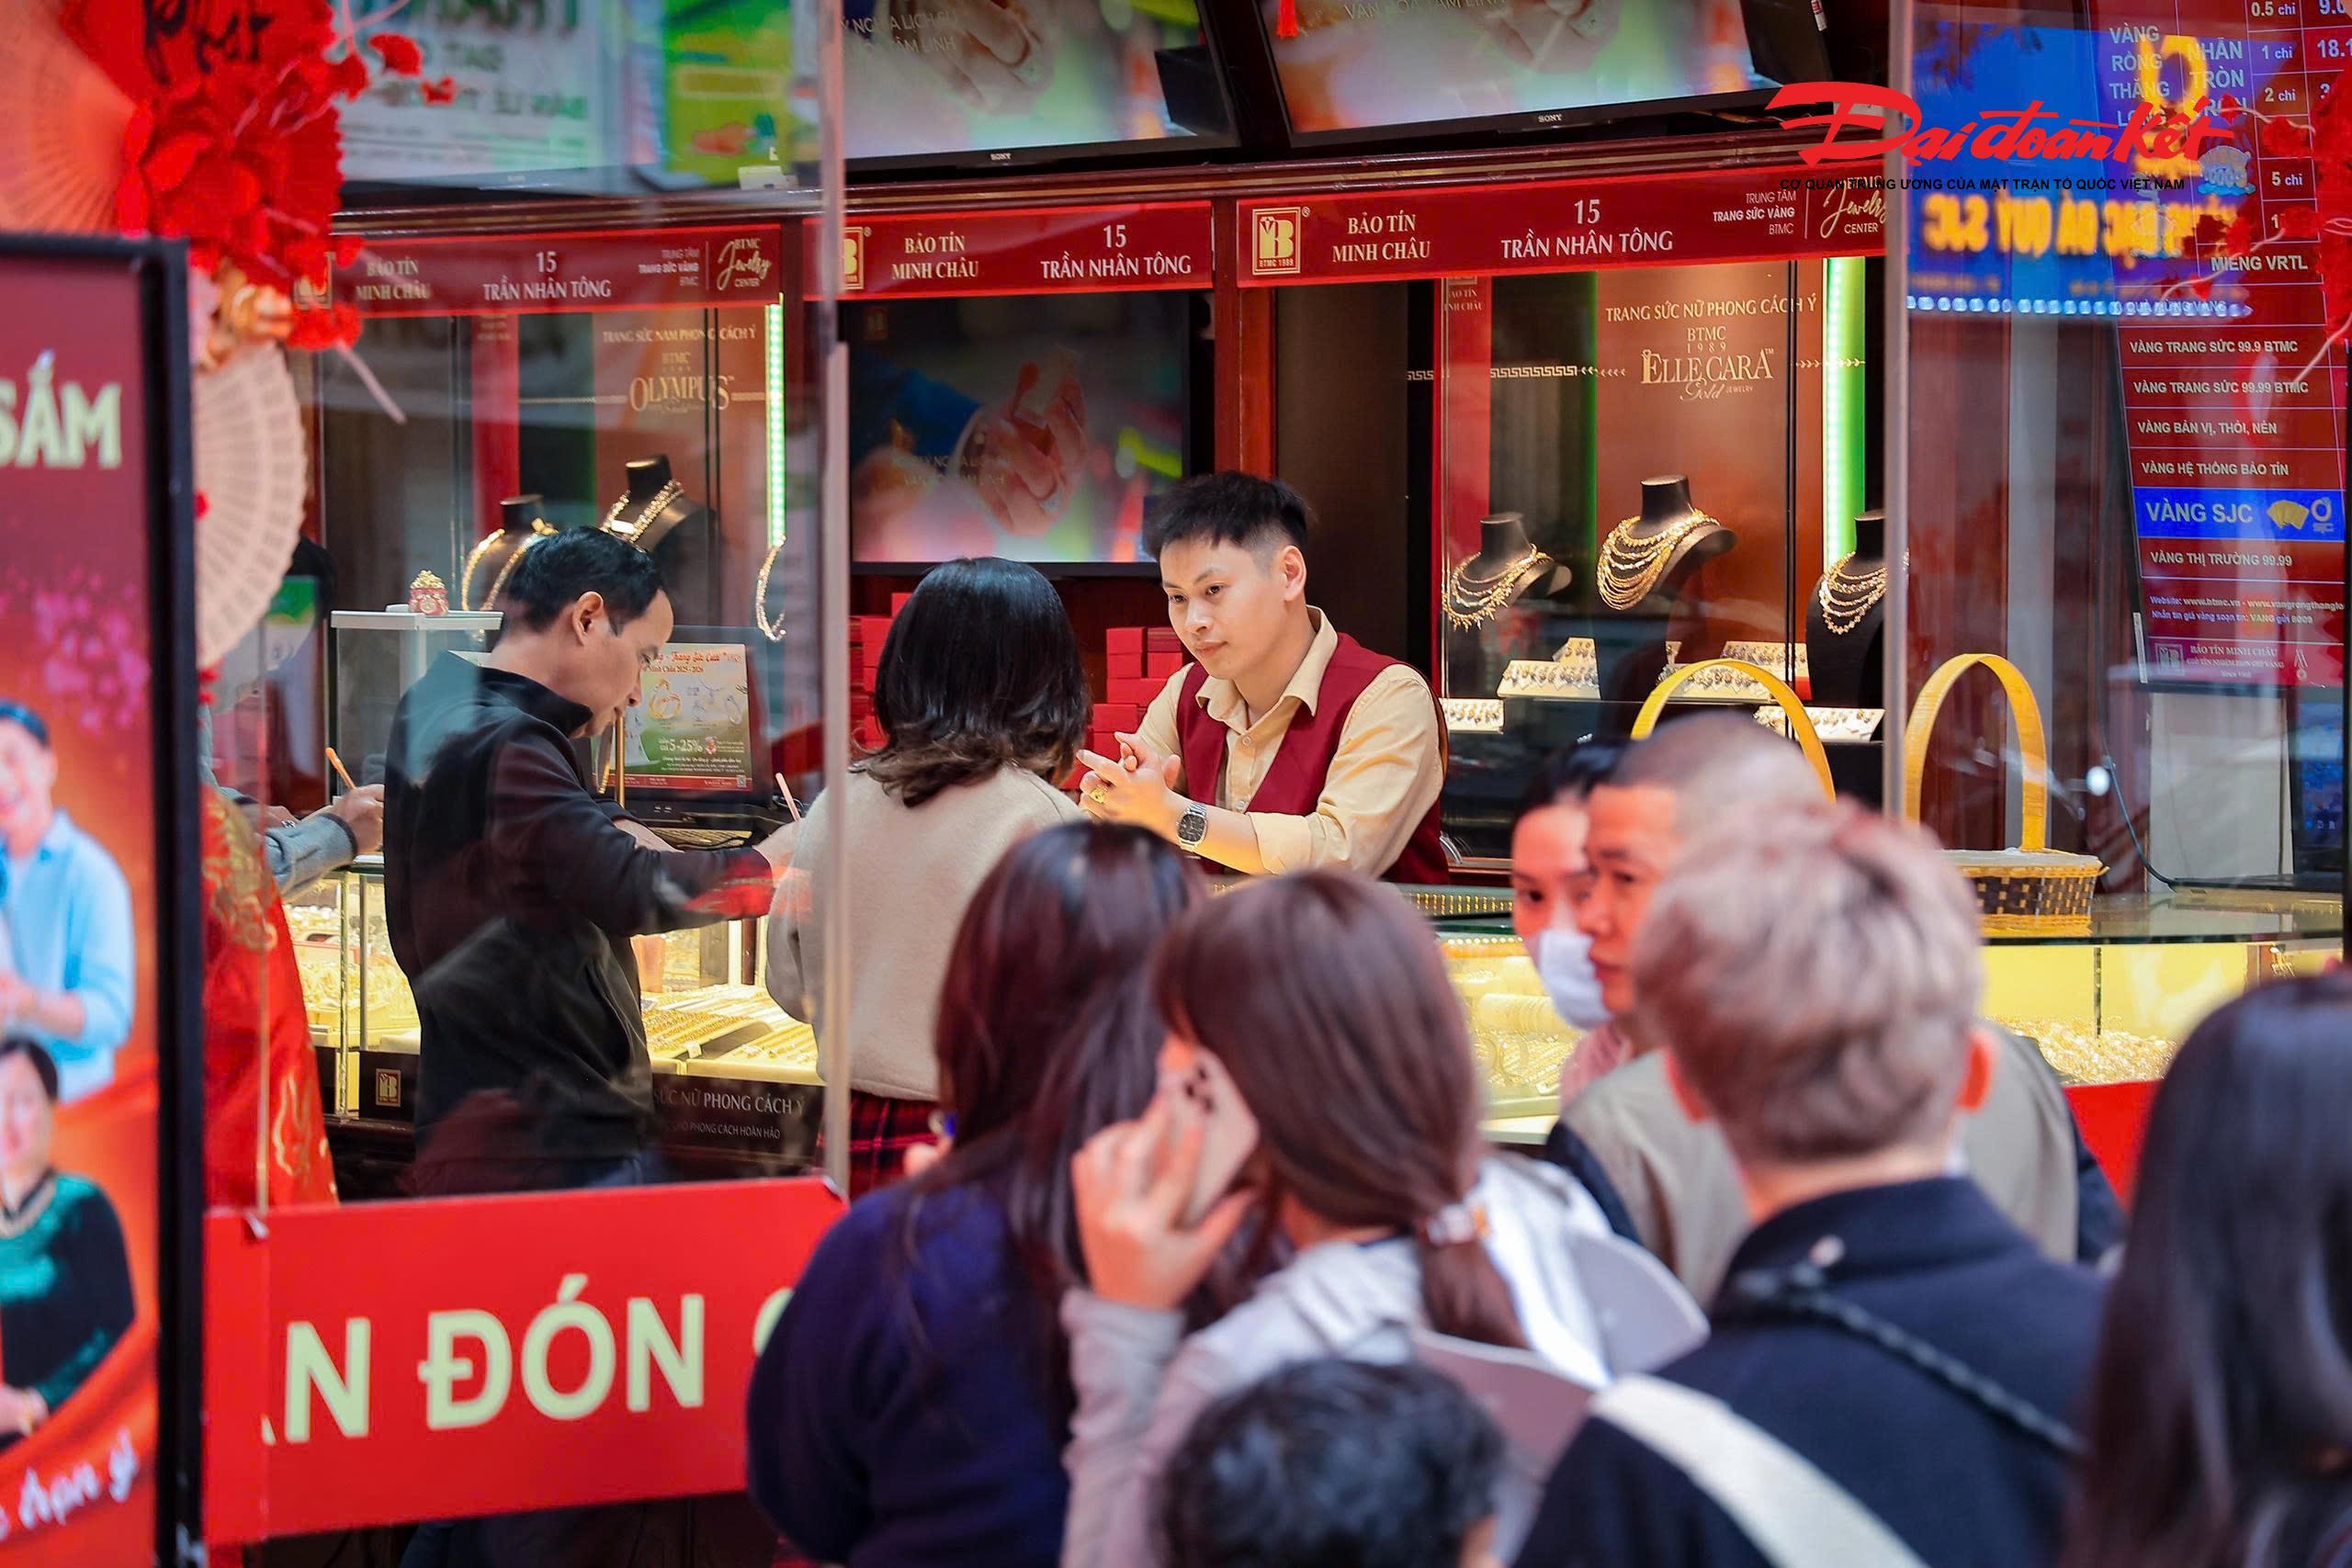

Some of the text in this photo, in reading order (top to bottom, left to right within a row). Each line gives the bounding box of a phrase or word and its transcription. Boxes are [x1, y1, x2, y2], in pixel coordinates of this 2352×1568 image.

[2251, 1, 2274, 17] 0.5
[2278, 3, 2295, 15] chi
[2109, 22, 2159, 43] VÀNG
[2262, 45, 2268, 60] 1
[2275, 46, 2292, 59] chi
[2111, 51, 2245, 88] RÒNG TRÒN
[2109, 78, 2295, 102] THĂNG 2 chi
[1538, 114, 1562, 122] SONY
[2271, 172, 2302, 186] 5 chi
[1746, 188, 1796, 204] TRUNG TÂM
[1348, 209, 1416, 234] BẢO TÍN
[1574, 198, 1600, 224] 15
[1713, 205, 1795, 222] TRANG SỨC VÀNG
[1102, 224, 1126, 248] 15
[1769, 222, 1794, 235] BTMC
[1844, 222, 1879, 234] CENTER
[905, 231, 965, 254] BẢO TÍN
[1332, 236, 1430, 263] MINH CHÂU
[1500, 227, 1673, 259] TRẦN NHÂN TÔNG
[537, 252, 557, 273] 15
[892, 257, 978, 279] MINH CHÂU
[1041, 251, 1192, 278] TRẦN NHÂN TÔNG
[2265, 254, 2308, 270] VRTL
[484, 276, 611, 300] TRẦN NHÂN TÔNG
[1607, 292, 1816, 321] TRANG SỨC NỮ PHONG CÁCH Ý
[1687, 326, 1726, 342] BTMC
[1687, 343, 1726, 354] 1989
[2130, 338, 2298, 353] VÀNG TRANG SỨC 99.9 BTMC
[629, 376, 729, 412] OLYMPUS
[2133, 379, 2308, 393] VÀNG TRANG SỨC 99.99 BTMC
[2137, 420, 2170, 434] VÀNG
[2142, 460, 2175, 474] VÀNG
[2177, 460, 2195, 478] HỆ
[2241, 461, 2267, 475] BẢO
[2269, 461, 2290, 476] TÍN
[2146, 498, 2253, 523] VÀNG SJC
[2150, 550, 2292, 567] VÀNG THỊ TRƯỜNG 99.99
[704, 1092, 751, 1111] PHONG
[755, 1093, 792, 1114] CÁCH
[690, 1122, 717, 1134] PHONG
[261, 1317, 371, 1445] N
[418, 1273, 704, 1431] ĐÓN
